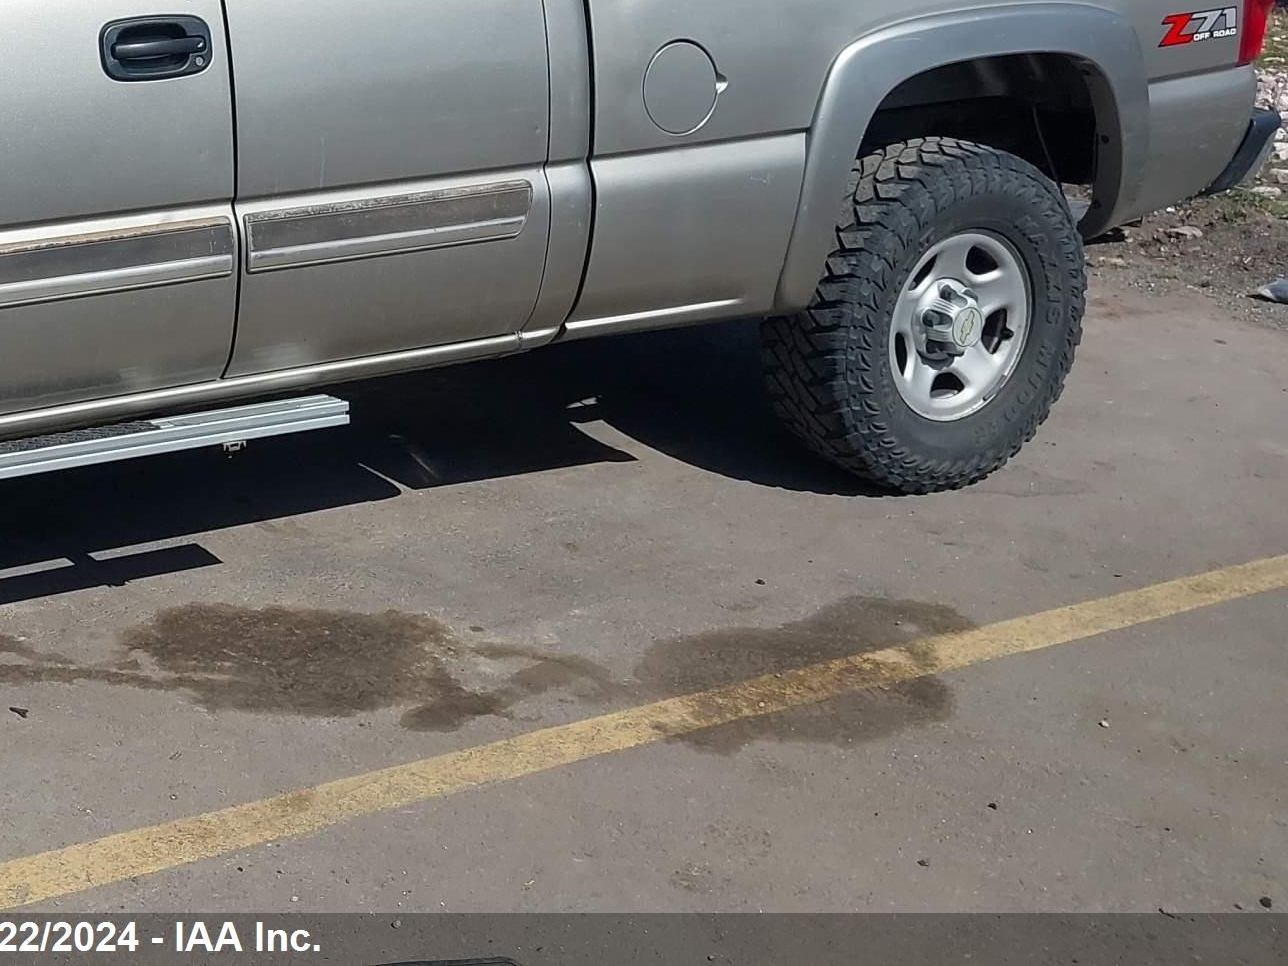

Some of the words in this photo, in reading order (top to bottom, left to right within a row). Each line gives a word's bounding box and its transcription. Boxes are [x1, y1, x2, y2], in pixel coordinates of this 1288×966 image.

[1158, 6, 1237, 47] Z71
[1193, 31, 1210, 41] OFF
[1213, 28, 1237, 38] ROAD
